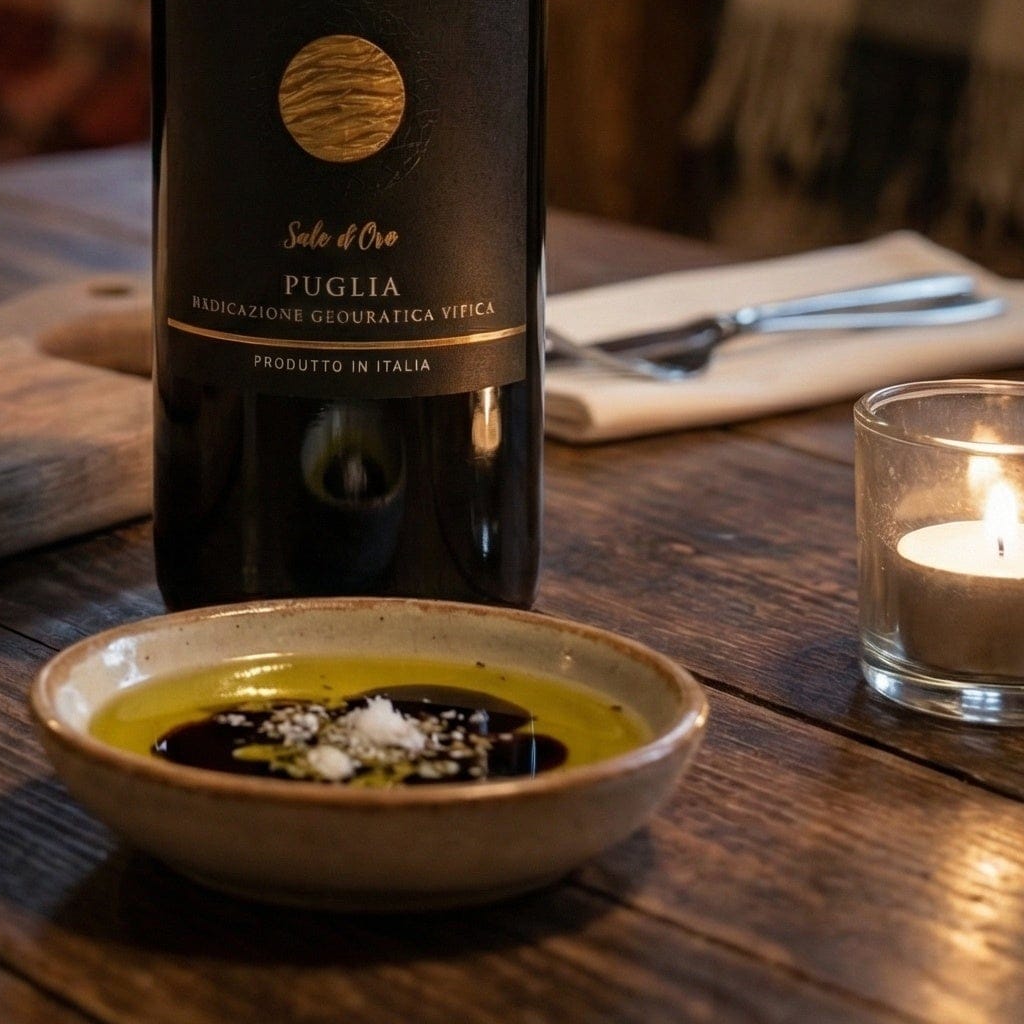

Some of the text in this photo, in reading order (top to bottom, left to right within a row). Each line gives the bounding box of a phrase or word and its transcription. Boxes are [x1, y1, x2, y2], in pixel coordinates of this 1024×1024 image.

[283, 275, 401, 297] PUGLIA
[254, 355, 431, 373] PRODUTTO IN ITALIA
